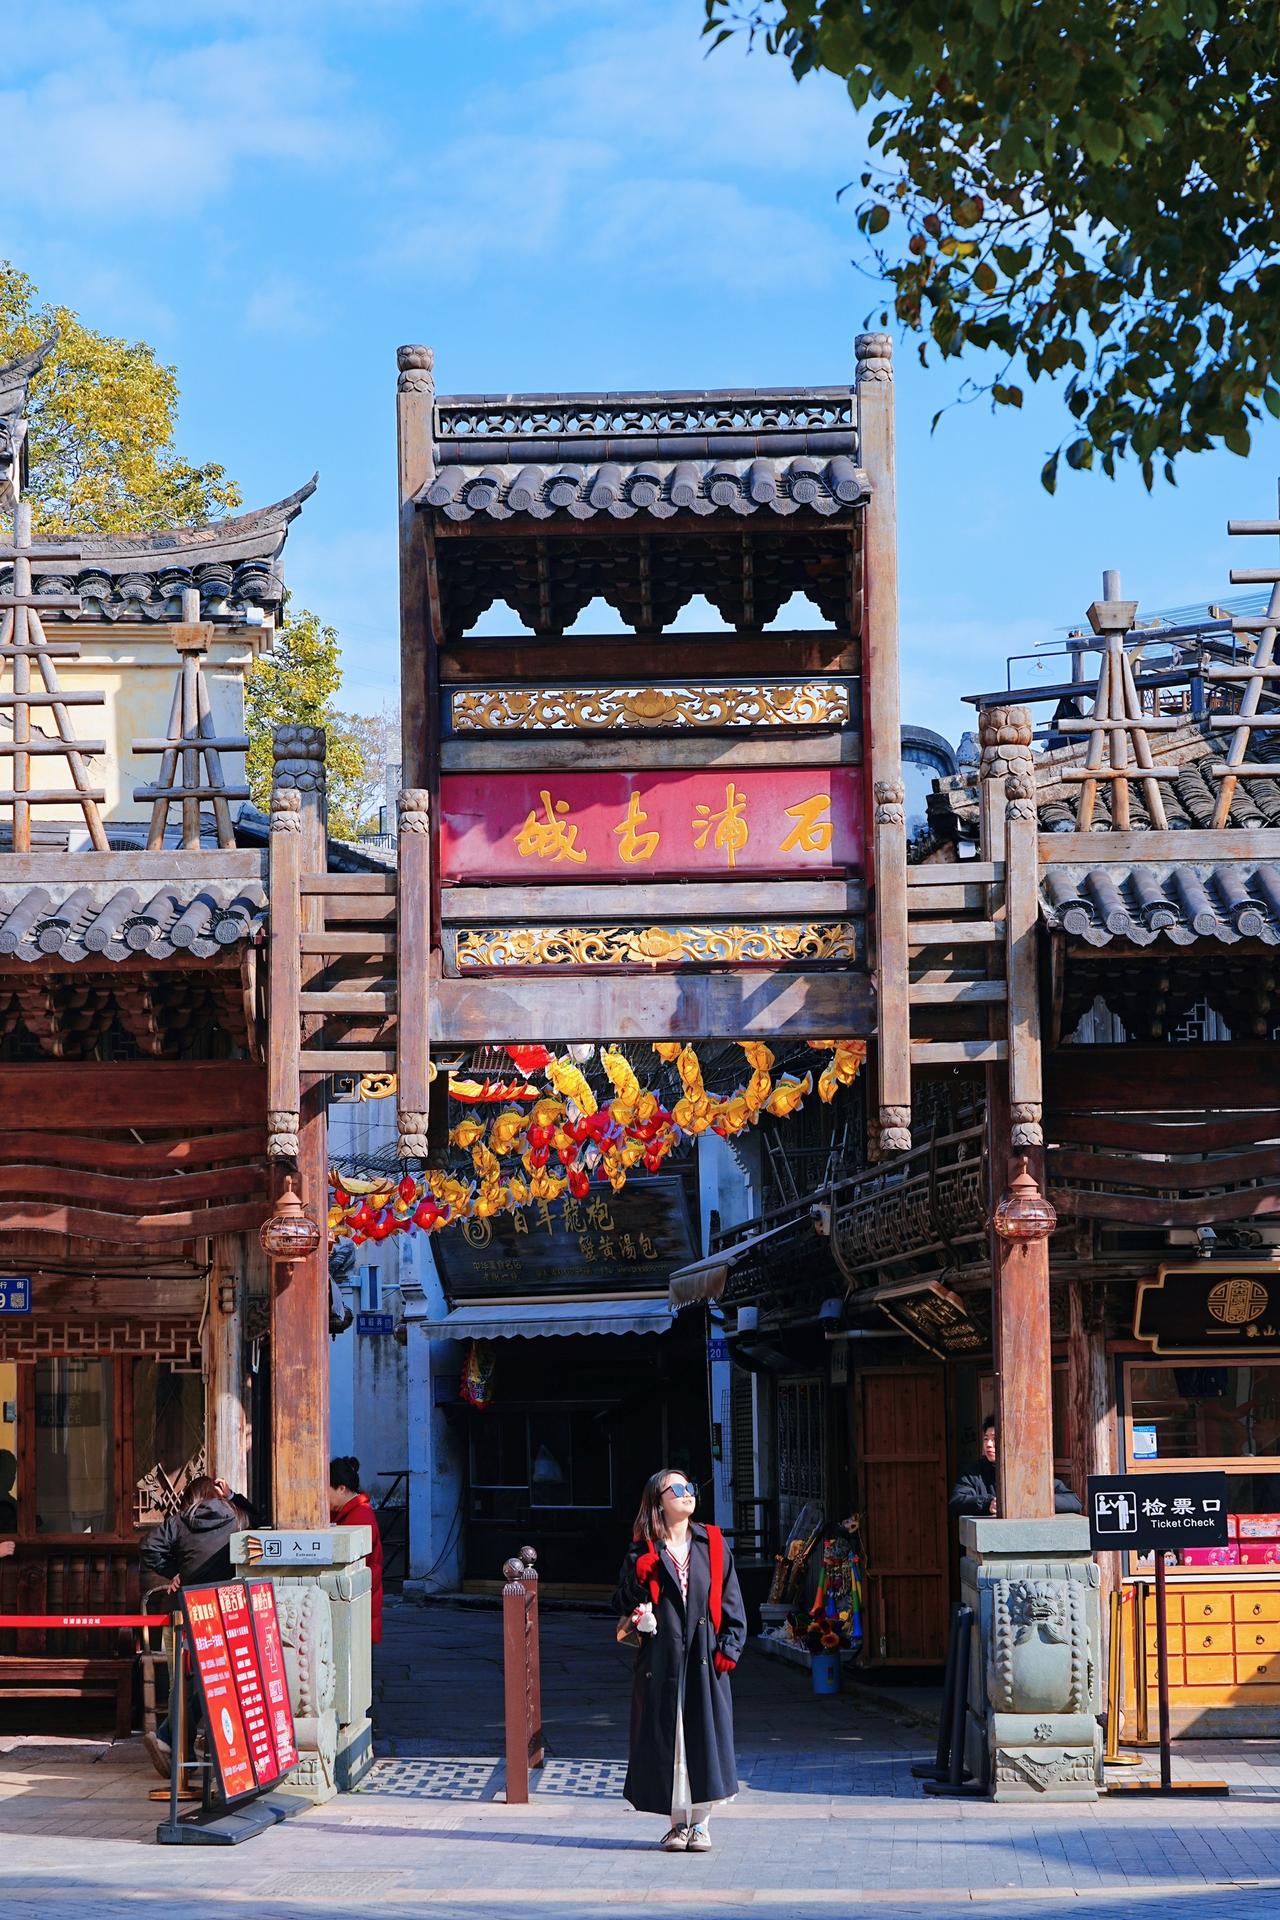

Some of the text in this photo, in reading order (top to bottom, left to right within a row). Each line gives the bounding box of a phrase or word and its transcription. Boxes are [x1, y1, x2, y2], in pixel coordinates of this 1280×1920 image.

[1246, 1324, 1280, 1338] 象山
[710, 1348, 721, 1358] 20
[40, 1415, 81, 1425] POLICE
[1141, 1498, 1221, 1516] 检票口
[1151, 1518, 1215, 1528] Ticket Check
[292, 1541, 321, 1551] 入口
